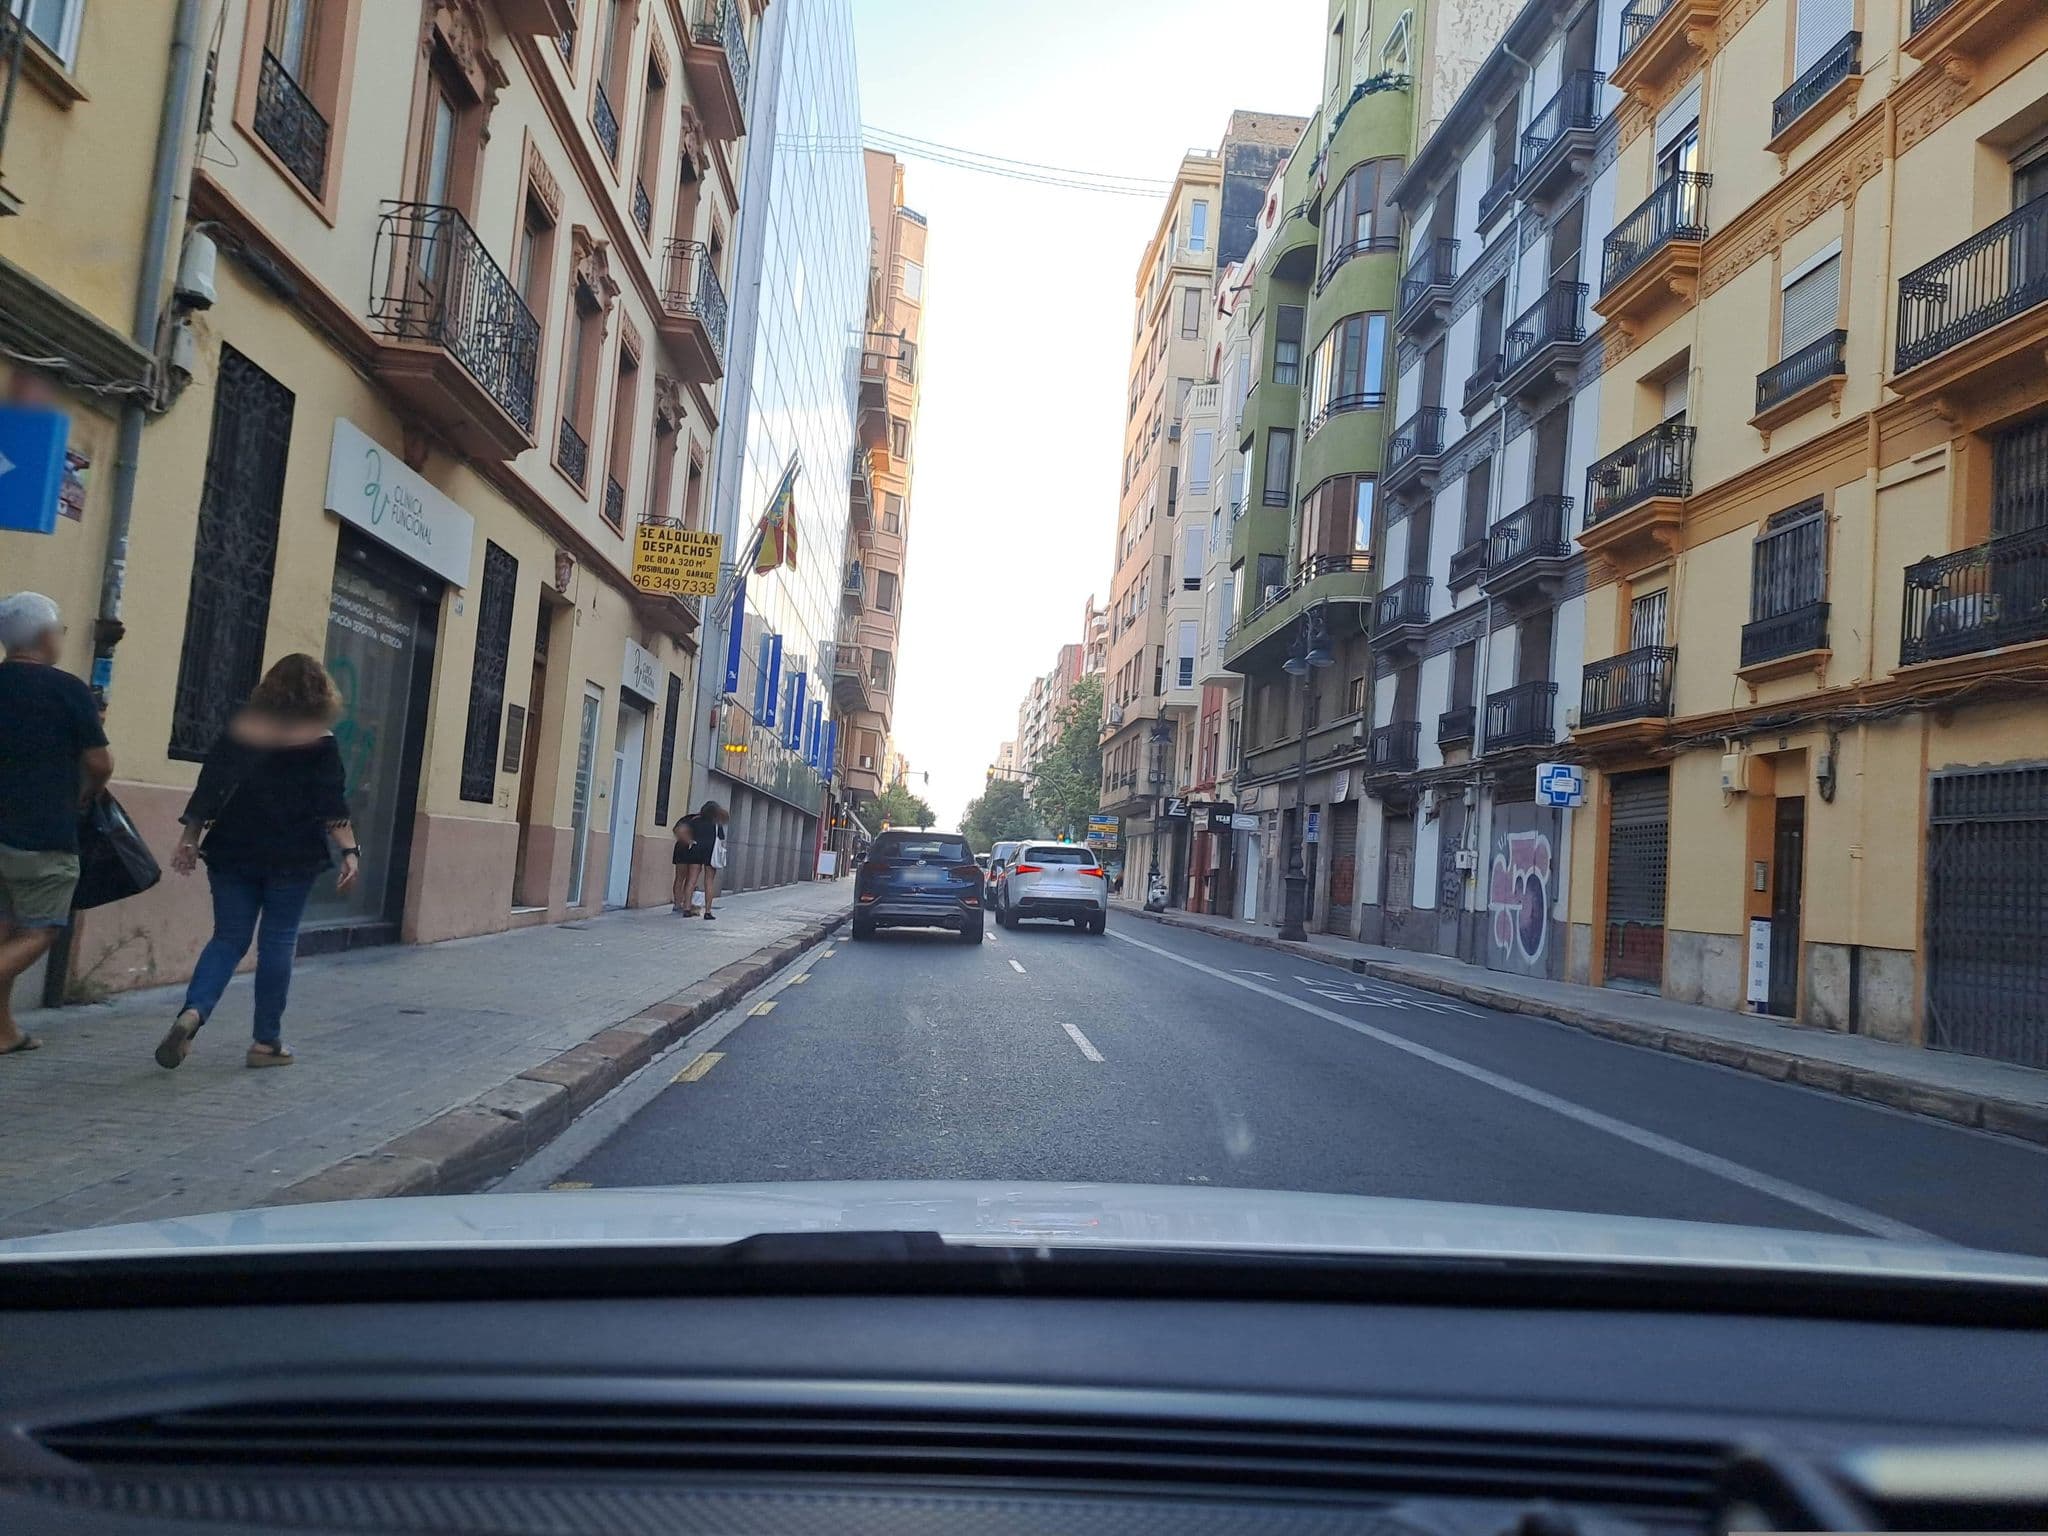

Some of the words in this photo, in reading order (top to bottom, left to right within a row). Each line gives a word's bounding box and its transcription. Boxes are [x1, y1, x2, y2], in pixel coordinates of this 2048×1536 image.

[391, 503, 433, 546] FUNCIONAL
[639, 527, 655, 539] SE
[658, 529, 719, 546] ALQUILAN
[642, 540, 713, 558] DESPACHOS
[644, 554, 655, 563] DE
[656, 555, 668, 564] 80
[678, 558, 695, 567] 320
[637, 564, 680, 576] POSIBILIDAD
[686, 569, 714, 580] GARAGE
[633, 574, 650, 587] 96
[653, 576, 716, 594] 3497333
[1306, 988, 1487, 1019] EMT
